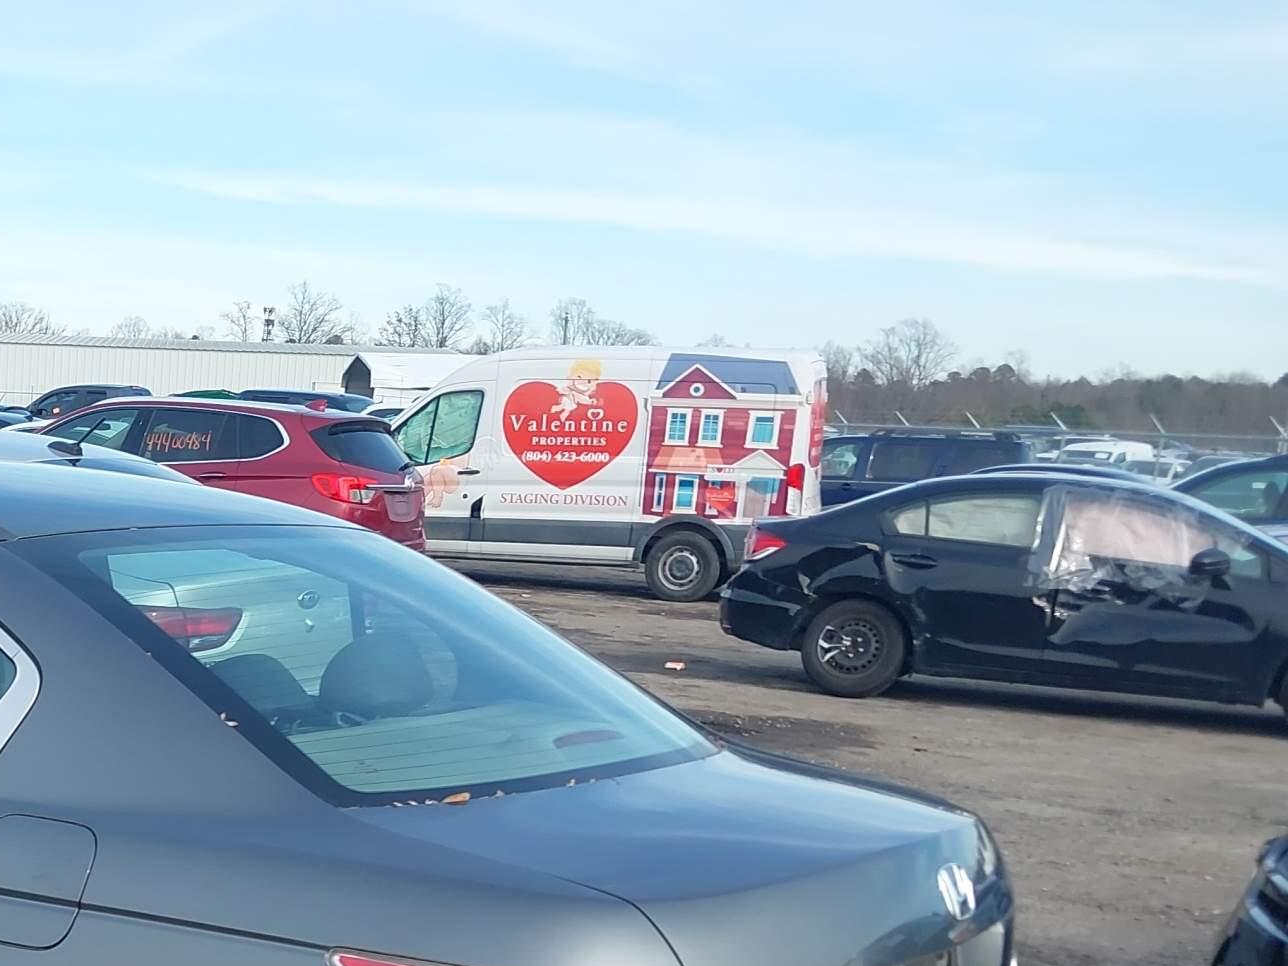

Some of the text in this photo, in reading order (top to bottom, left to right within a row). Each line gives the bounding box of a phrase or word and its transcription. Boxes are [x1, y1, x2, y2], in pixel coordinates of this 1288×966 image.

[509, 412, 628, 432] Valentine
[531, 436, 607, 446] PROPERTIES
[521, 450, 610, 462] (804) 423-6000
[500, 493, 629, 506] STAGING DIVISION
